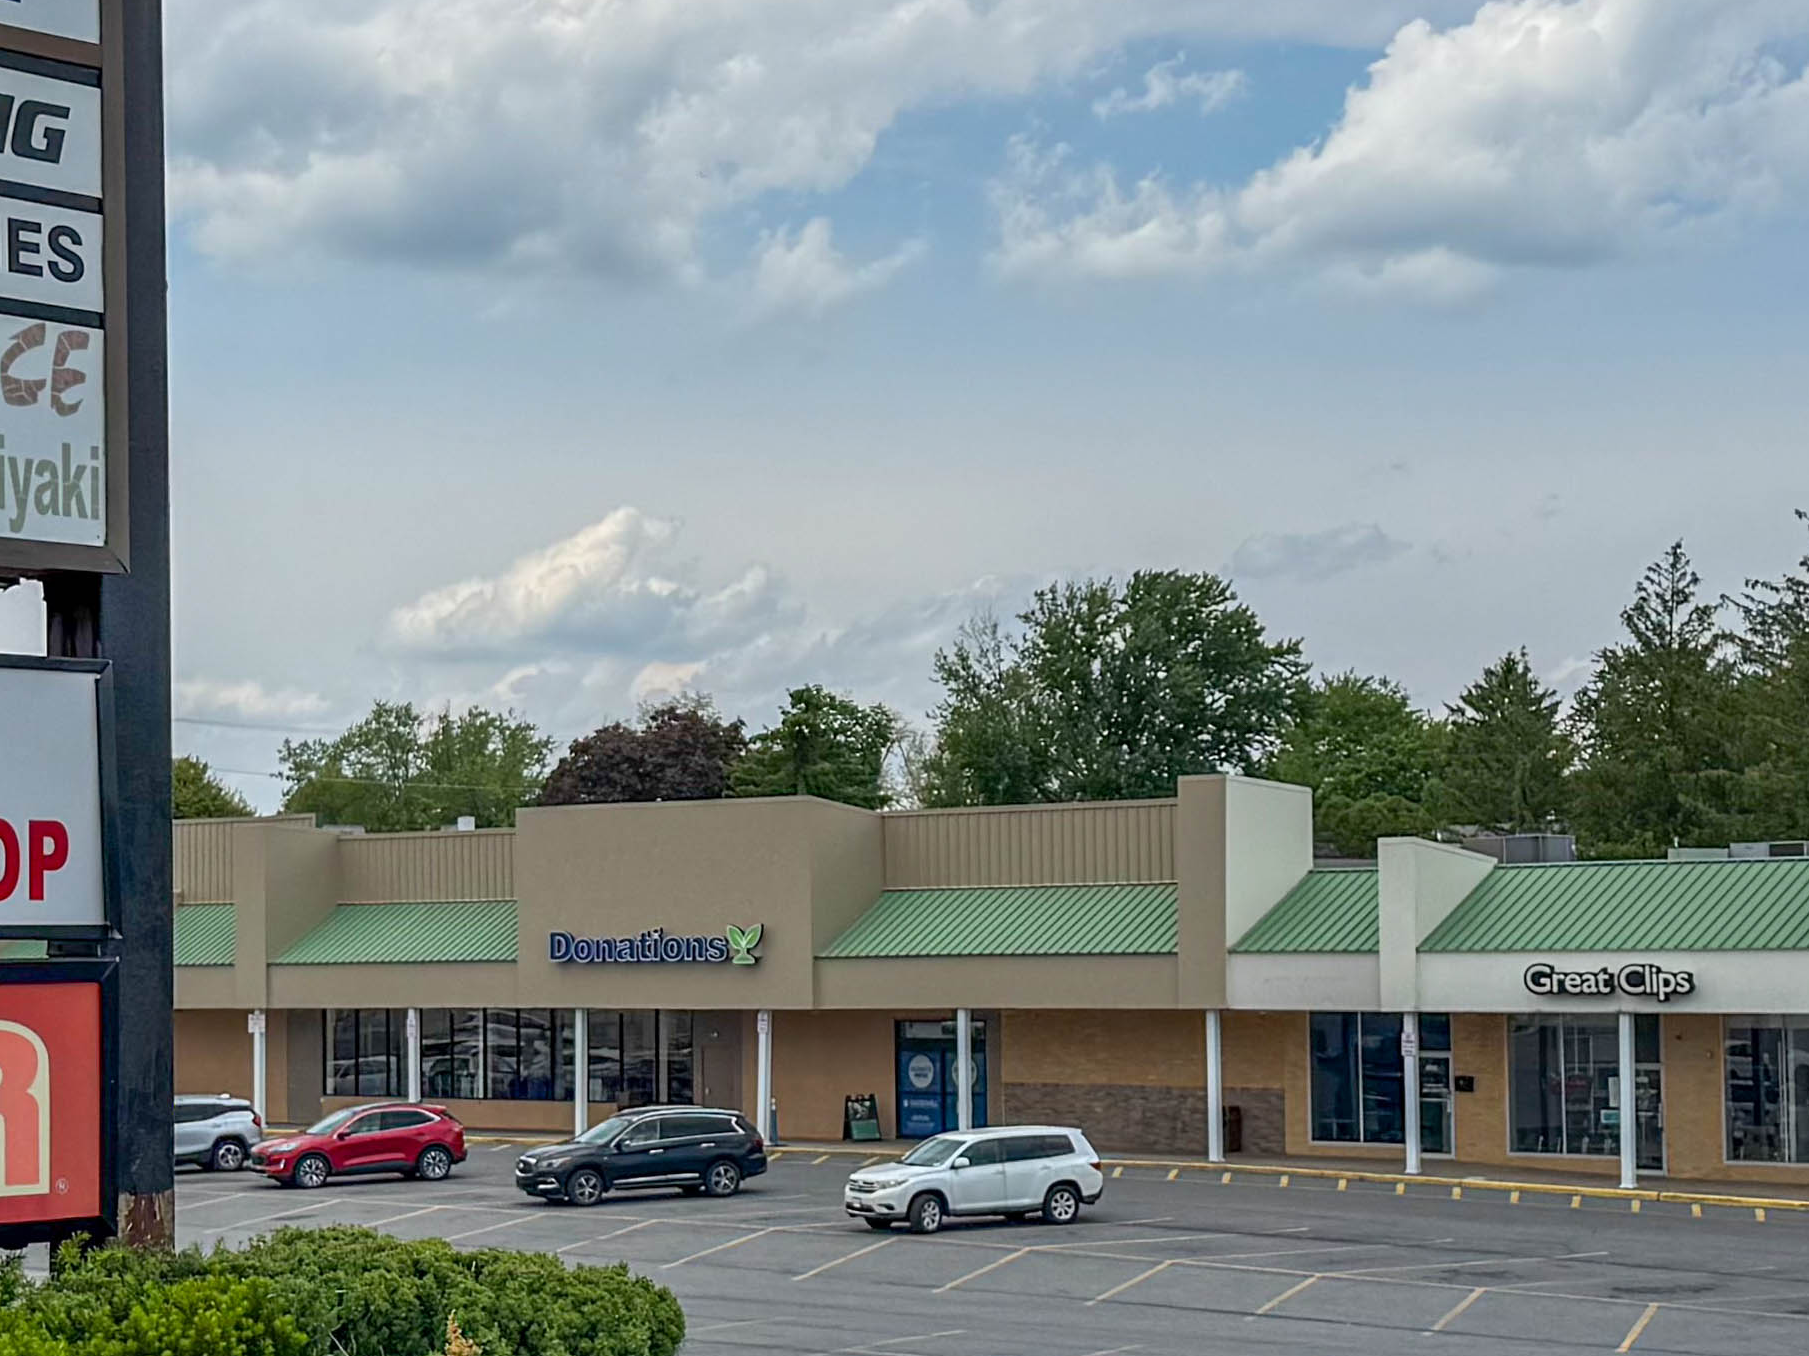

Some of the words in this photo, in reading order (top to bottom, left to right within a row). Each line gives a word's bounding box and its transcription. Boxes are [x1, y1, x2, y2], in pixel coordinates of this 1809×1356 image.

[549, 927, 728, 963] Donations
[1524, 963, 1615, 995] Great
[1618, 963, 1695, 1003] Clips
